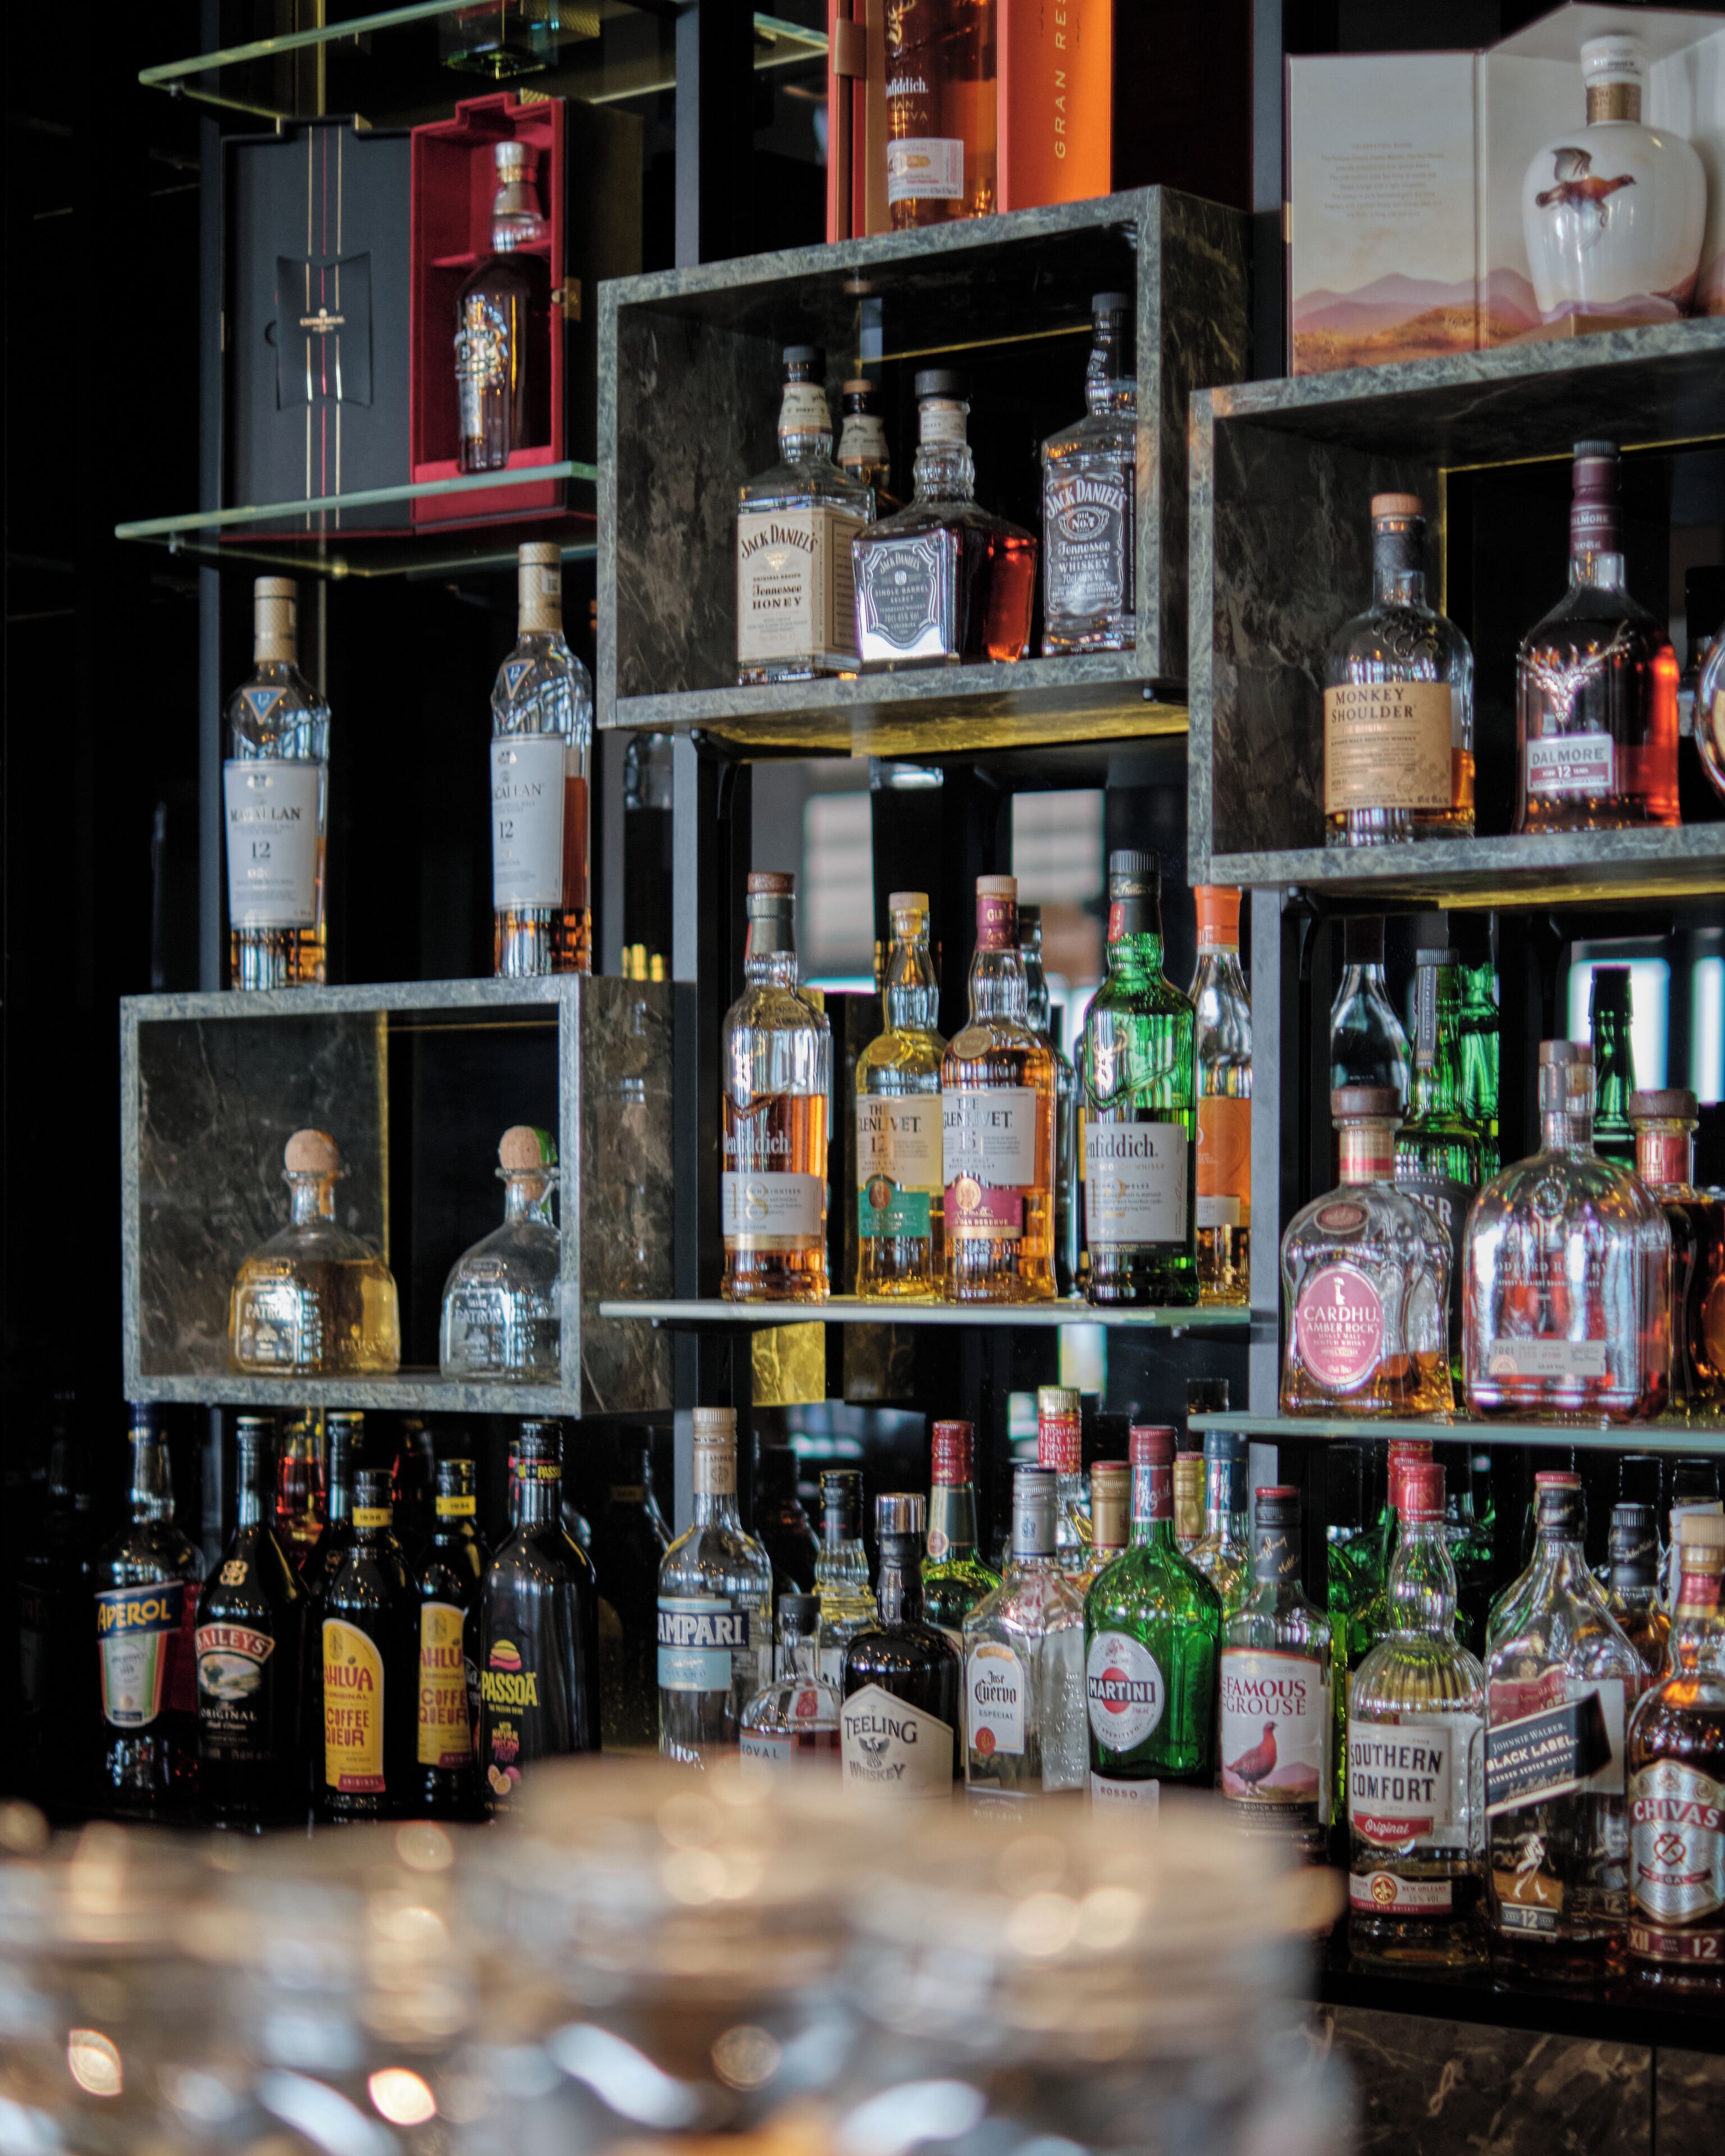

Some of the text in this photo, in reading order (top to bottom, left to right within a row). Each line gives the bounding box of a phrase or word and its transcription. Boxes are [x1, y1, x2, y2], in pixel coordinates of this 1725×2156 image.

[1056, 71, 1066, 159] GRAN
[1046, 478, 1128, 520] JACK DANIEL'S
[742, 523, 818, 560] JACK DANIEL'S
[1057, 541, 1111, 556] Tennessee
[1058, 558, 1110, 574] WHISKEY
[752, 583, 802, 597] Tennessee
[901, 584, 929, 593] BARREL
[752, 597, 802, 610] HONEY
[509, 665, 521, 679] 12
[1335, 688, 1404, 706] MONKEY
[1331, 705, 1414, 724] SHOULDER
[1532, 747, 1604, 766] DALMORE
[1557, 765, 1572, 779] 12
[500, 819, 514, 839] 12
[252, 841, 271, 859] 12
[1086, 1132, 1158, 1159] enfiddich.
[1134, 1162, 1165, 1171] WHISKY
[732, 1182, 769, 1221] 18
[245, 1302, 294, 1320] PATR
[1303, 1305, 1376, 1322] CARDHU
[1307, 1321, 1375, 1334] AMBER ROCK
[97, 1598, 171, 1633] APEROL
[988, 1670, 1005, 1685] Jose
[1226, 1675, 1306, 1698] FAMOUS
[974, 1678, 1017, 1706] Cuervo
[1089, 1678, 1153, 1702] MARTINI
[979, 1710, 1015, 1721] ESPECIAL
[1226, 1695, 1306, 1716] GROUSE
[326, 1707, 369, 1729] COFFEE
[845, 1715, 918, 1745] TEELING
[1493, 1723, 1563, 1755] JOHNNIE WALKER
[742, 1743, 780, 1760] KOVAL
[1350, 1742, 1444, 1775] SOUTHERN
[1486, 1734, 1574, 1772] BLACK LABEL
[1547, 1752, 1573, 1767] WHISKY
[849, 1758, 906, 1782] WHISKEY
[1100, 1785, 1138, 1800] ROSSO
[1634, 1799, 1719, 1828] CHIVAS
[1365, 1817, 1410, 1837] Original
[1521, 1909, 1538, 1929] 12
[1630, 1927, 1649, 1952] XII
[1692, 1936, 1717, 1958] 12
